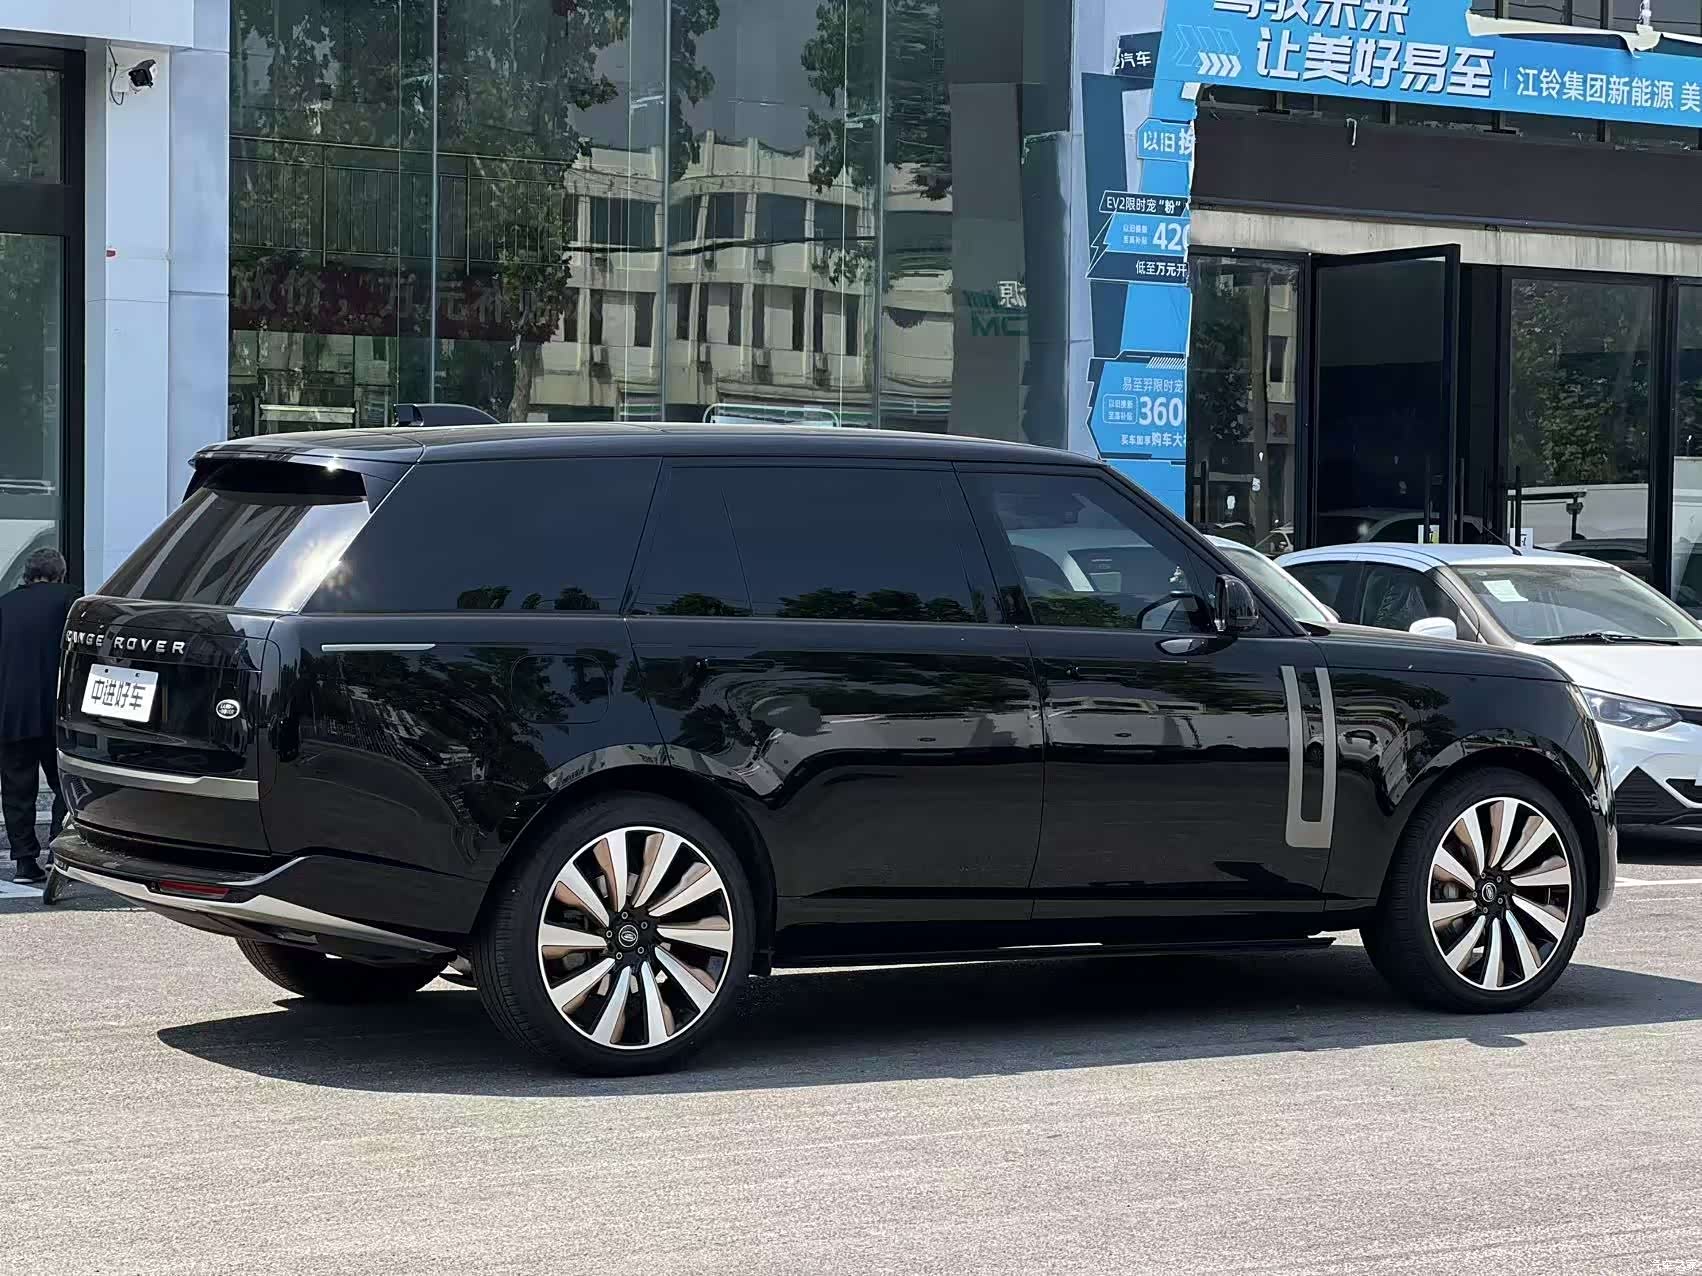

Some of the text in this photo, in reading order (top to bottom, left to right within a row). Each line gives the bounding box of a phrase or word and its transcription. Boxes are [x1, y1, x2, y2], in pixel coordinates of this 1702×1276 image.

[1113, 51, 1152, 74] 汽车
[1256, 27, 1496, 97] 让美好易至
[1516, 66, 1701, 112] 江铃集团新能源 美
[114, 636, 186, 654] ROVER
